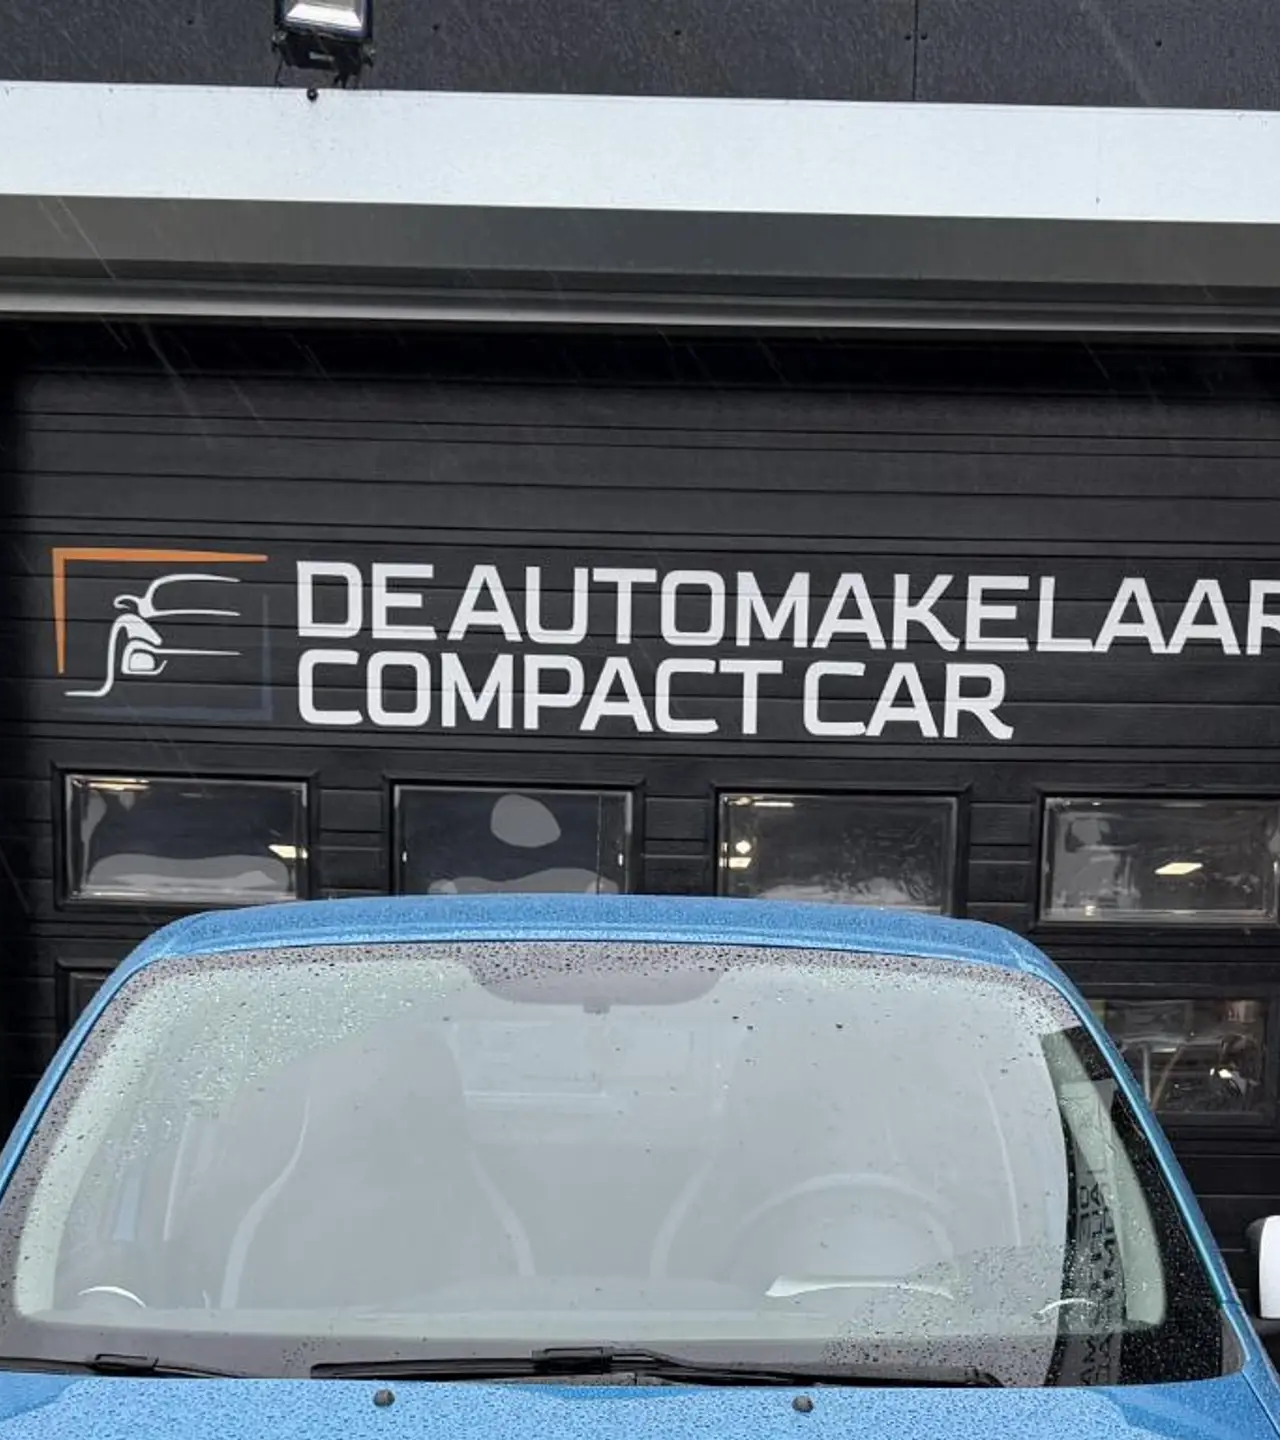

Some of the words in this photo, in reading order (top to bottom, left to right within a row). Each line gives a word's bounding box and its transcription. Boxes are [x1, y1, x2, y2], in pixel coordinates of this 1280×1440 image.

[297, 561, 437, 640] DE
[299, 649, 782, 734] COMPACT
[804, 661, 1013, 739] CAR
